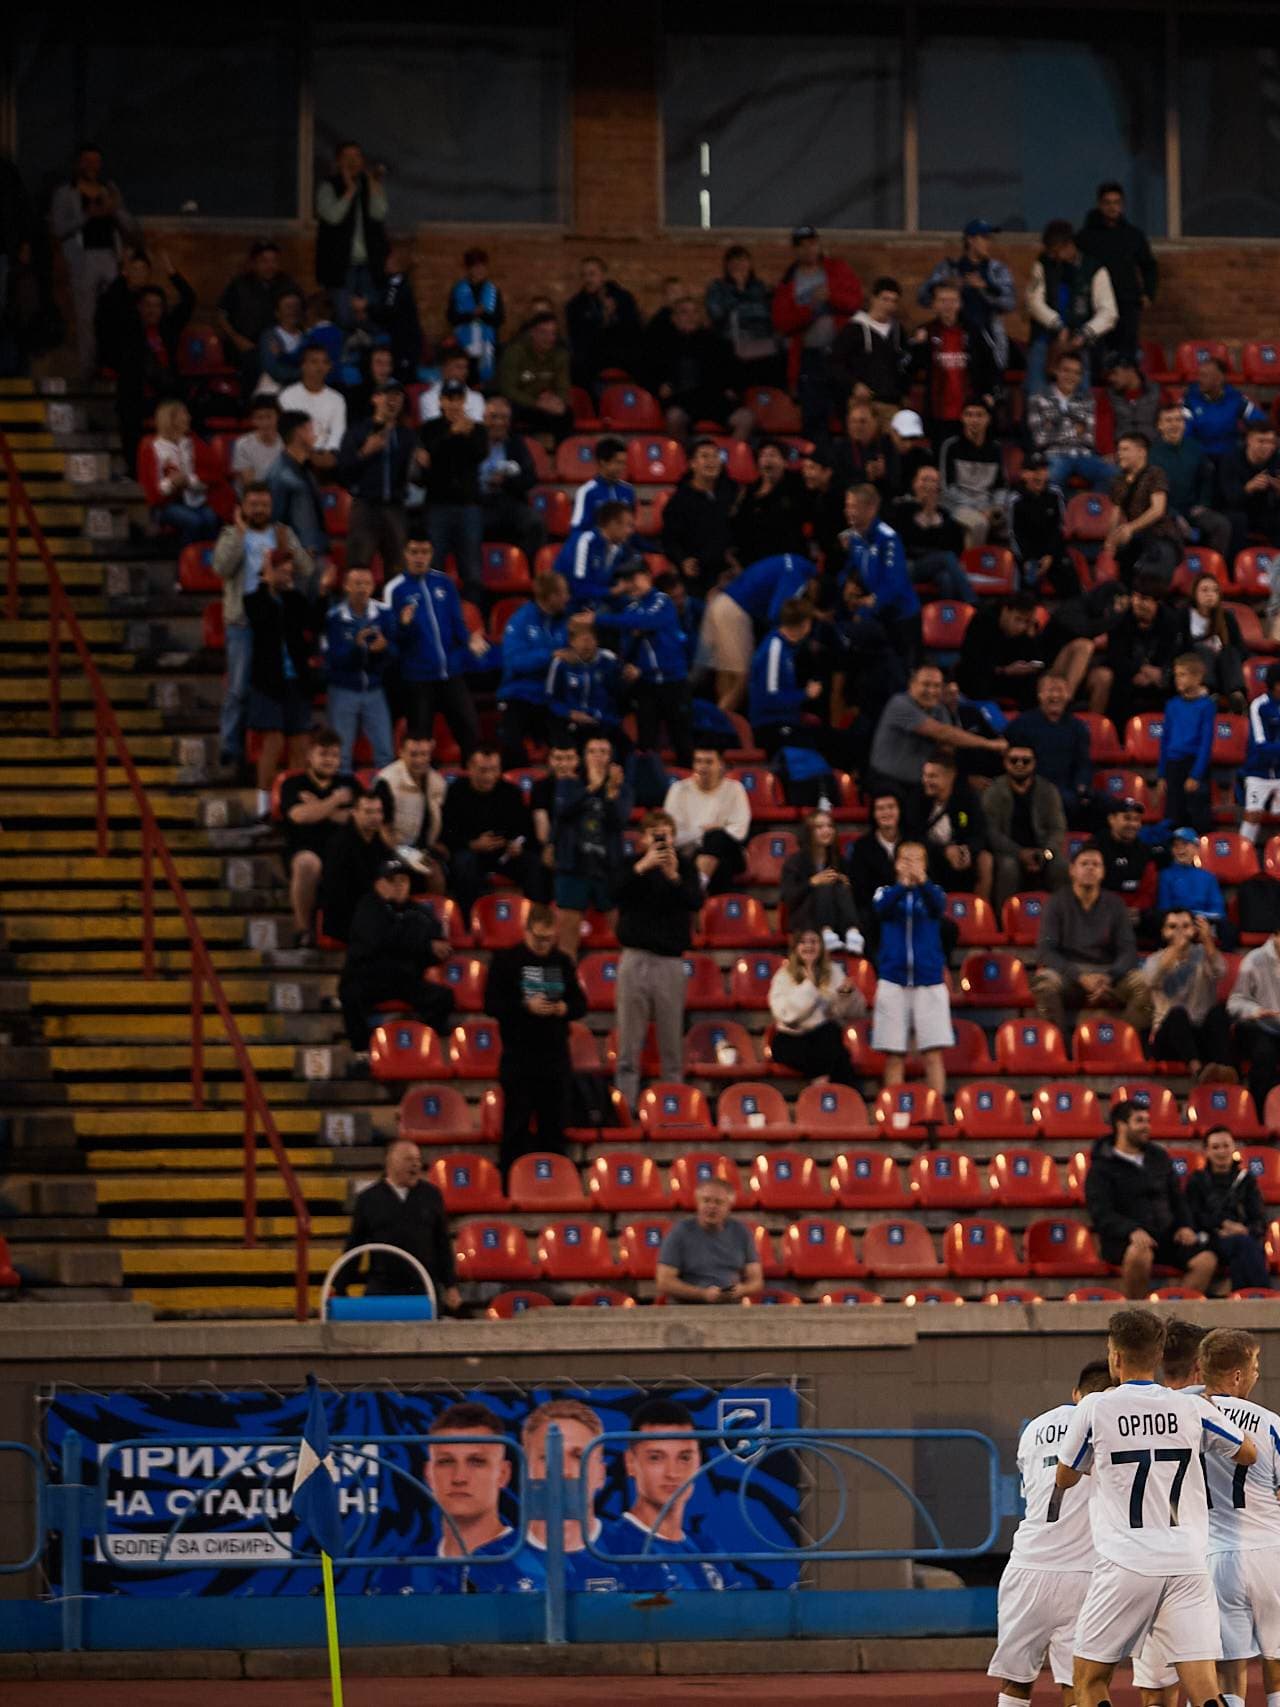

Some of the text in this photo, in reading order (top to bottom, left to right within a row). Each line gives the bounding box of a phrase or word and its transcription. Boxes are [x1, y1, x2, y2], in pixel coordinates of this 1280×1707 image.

[1118, 1412, 1178, 1437] ОРЛОВ
[1217, 1406, 1260, 1433] ТКИН
[97, 1443, 379, 1482] ПРИХОИ
[166, 1487, 379, 1519] СТАДИН!
[1110, 1448, 1192, 1529] 77
[177, 1538, 199, 1554] ЗА
[204, 1537, 275, 1553] СИБИРЬ
